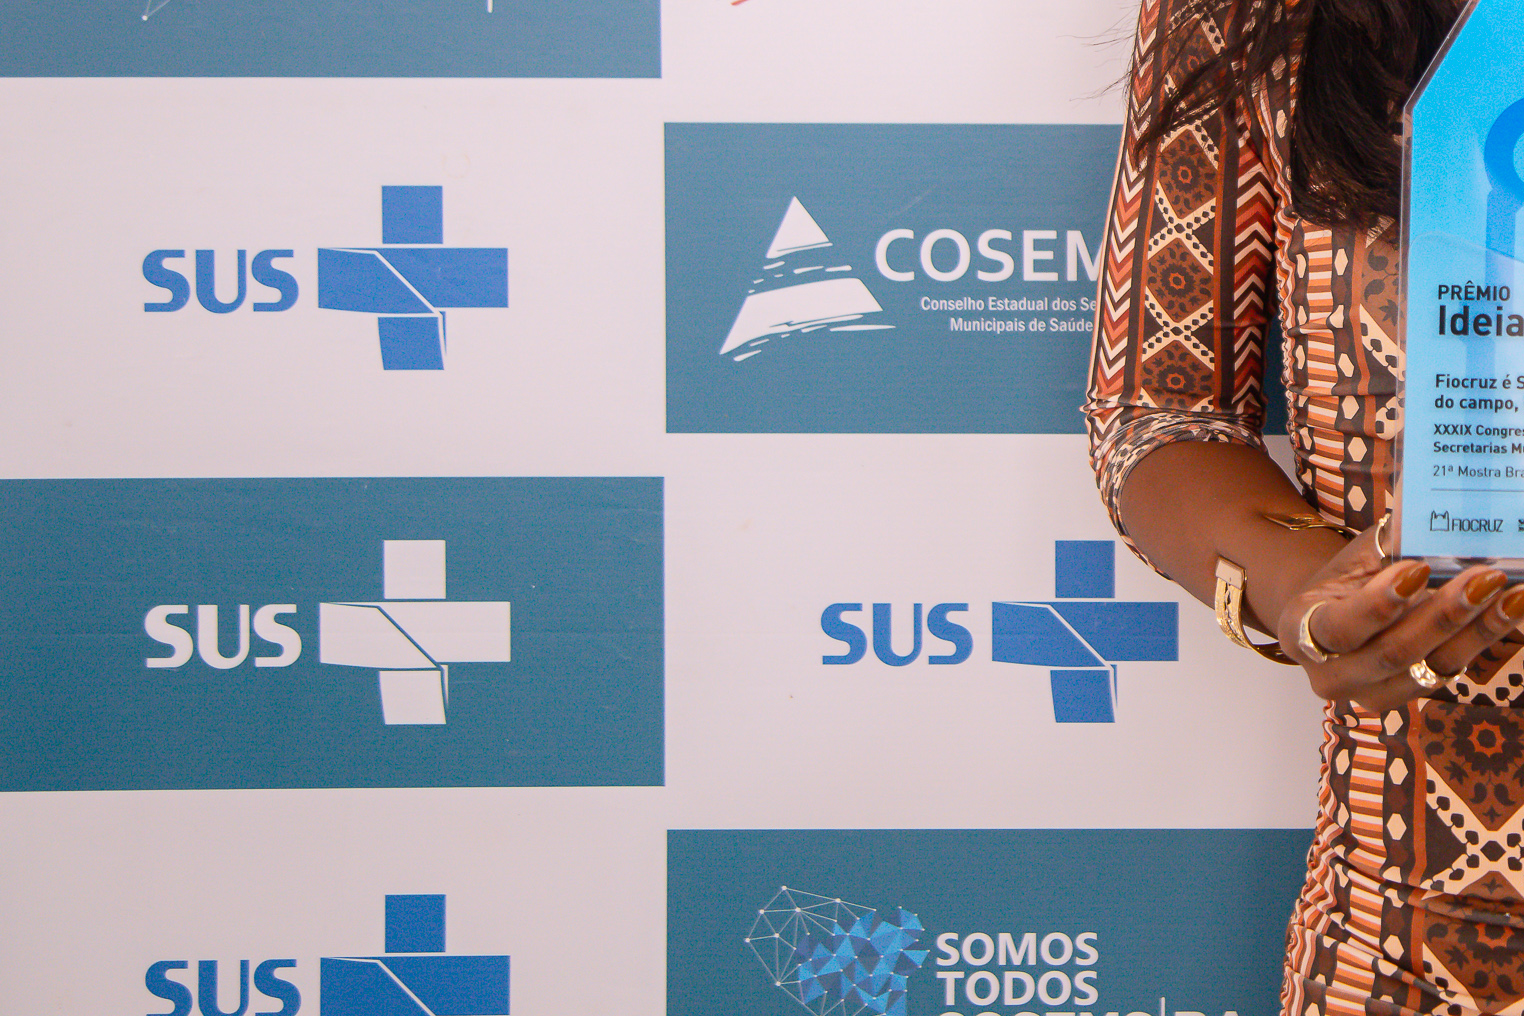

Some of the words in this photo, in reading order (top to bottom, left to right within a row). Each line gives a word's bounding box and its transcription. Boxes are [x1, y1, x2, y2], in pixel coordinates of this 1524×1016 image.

[875, 228, 1102, 282] COSEM
[142, 249, 298, 314] SUS
[1438, 280, 1510, 301] PRÊMIO
[920, 296, 984, 310] Conselho
[988, 297, 1048, 310] Estadual
[1052, 297, 1076, 310] dos
[950, 318, 1025, 334] Municipais
[1028, 318, 1046, 331] de
[1050, 317, 1093, 331] Saúde
[1436, 374, 1497, 389] Fiocruz
[1502, 374, 1511, 389] é
[1435, 395, 1454, 408] do
[1460, 399, 1518, 413] campo,
[1434, 424, 1472, 435] XXXIX
[1434, 442, 1507, 454] Secretarias
[1433, 465, 1453, 476] 21ª
[1458, 466, 1500, 477] Mostra
[1452, 519, 1503, 532] FIOCRUZ
[144, 604, 302, 669] SUS
[821, 603, 972, 666] SUS
[936, 932, 1098, 966] SOMOS
[145, 959, 300, 1016] SUS
[936, 970, 1098, 1006] TODOS
